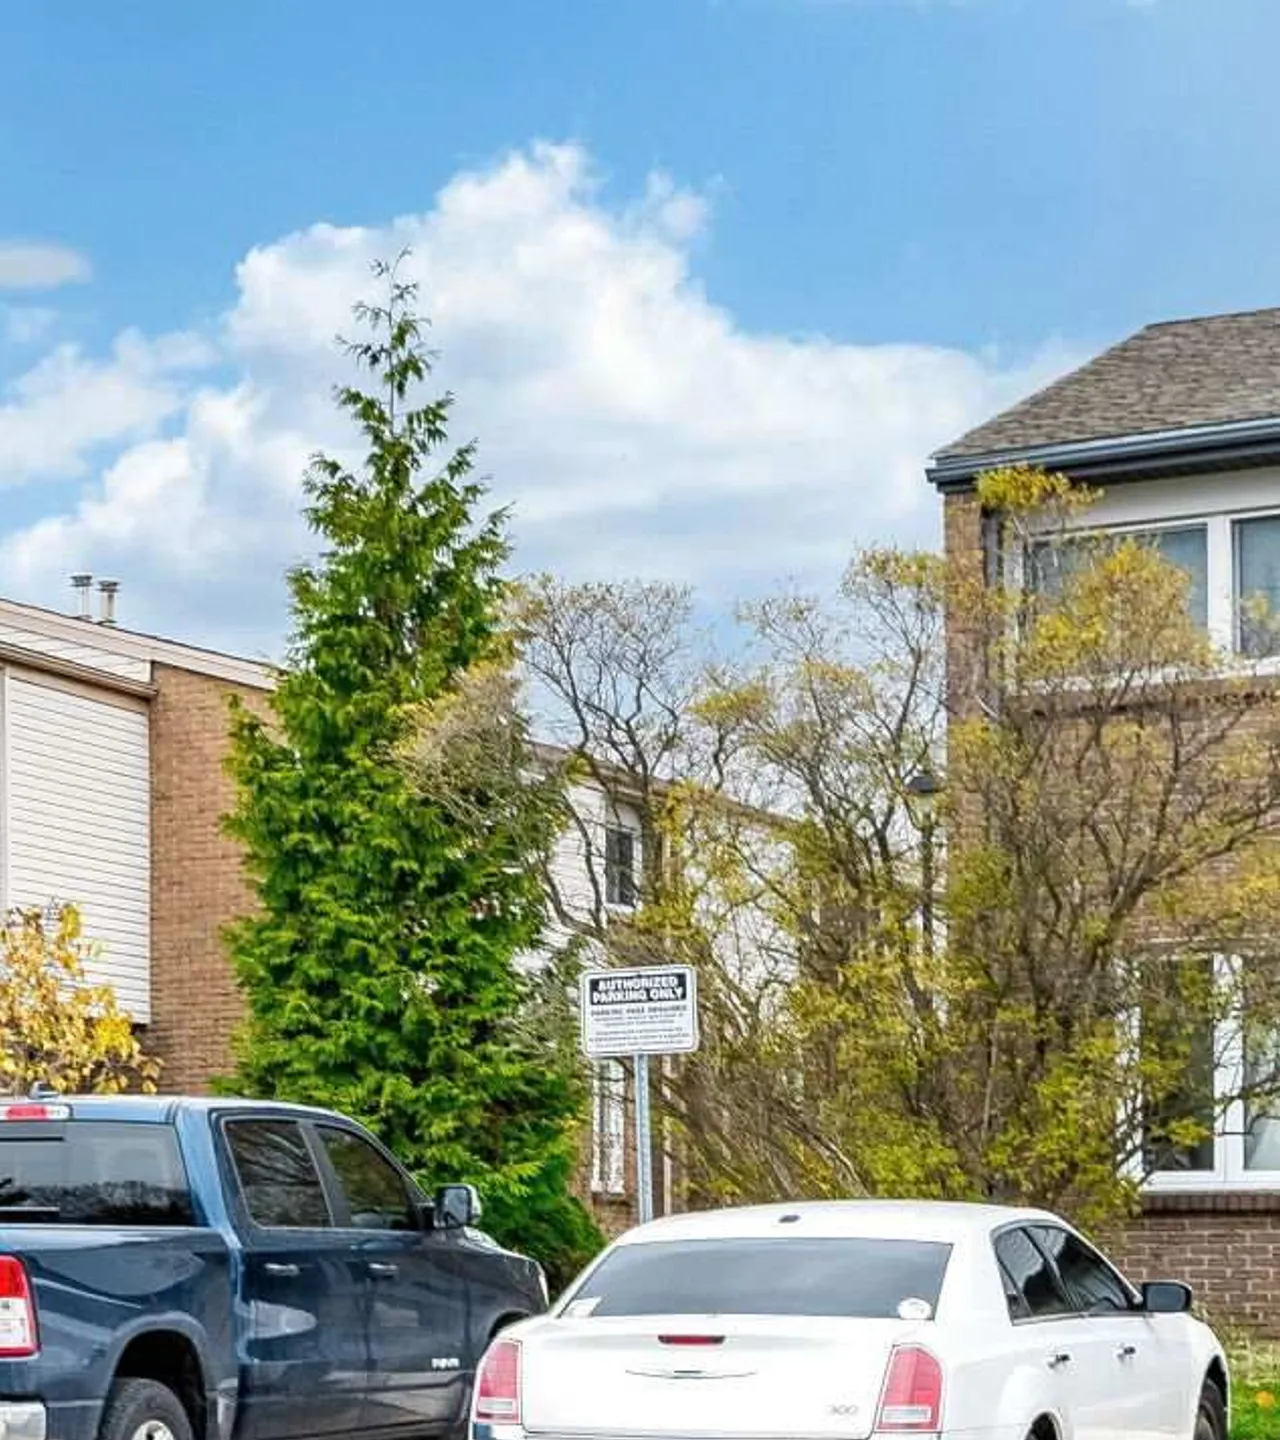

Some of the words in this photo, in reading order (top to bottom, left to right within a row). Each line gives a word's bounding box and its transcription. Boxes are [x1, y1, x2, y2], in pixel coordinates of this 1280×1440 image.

[598, 976, 679, 991] AUTHORIZED
[592, 989, 647, 1004] PARKING
[649, 987, 683, 1000] ONLY
